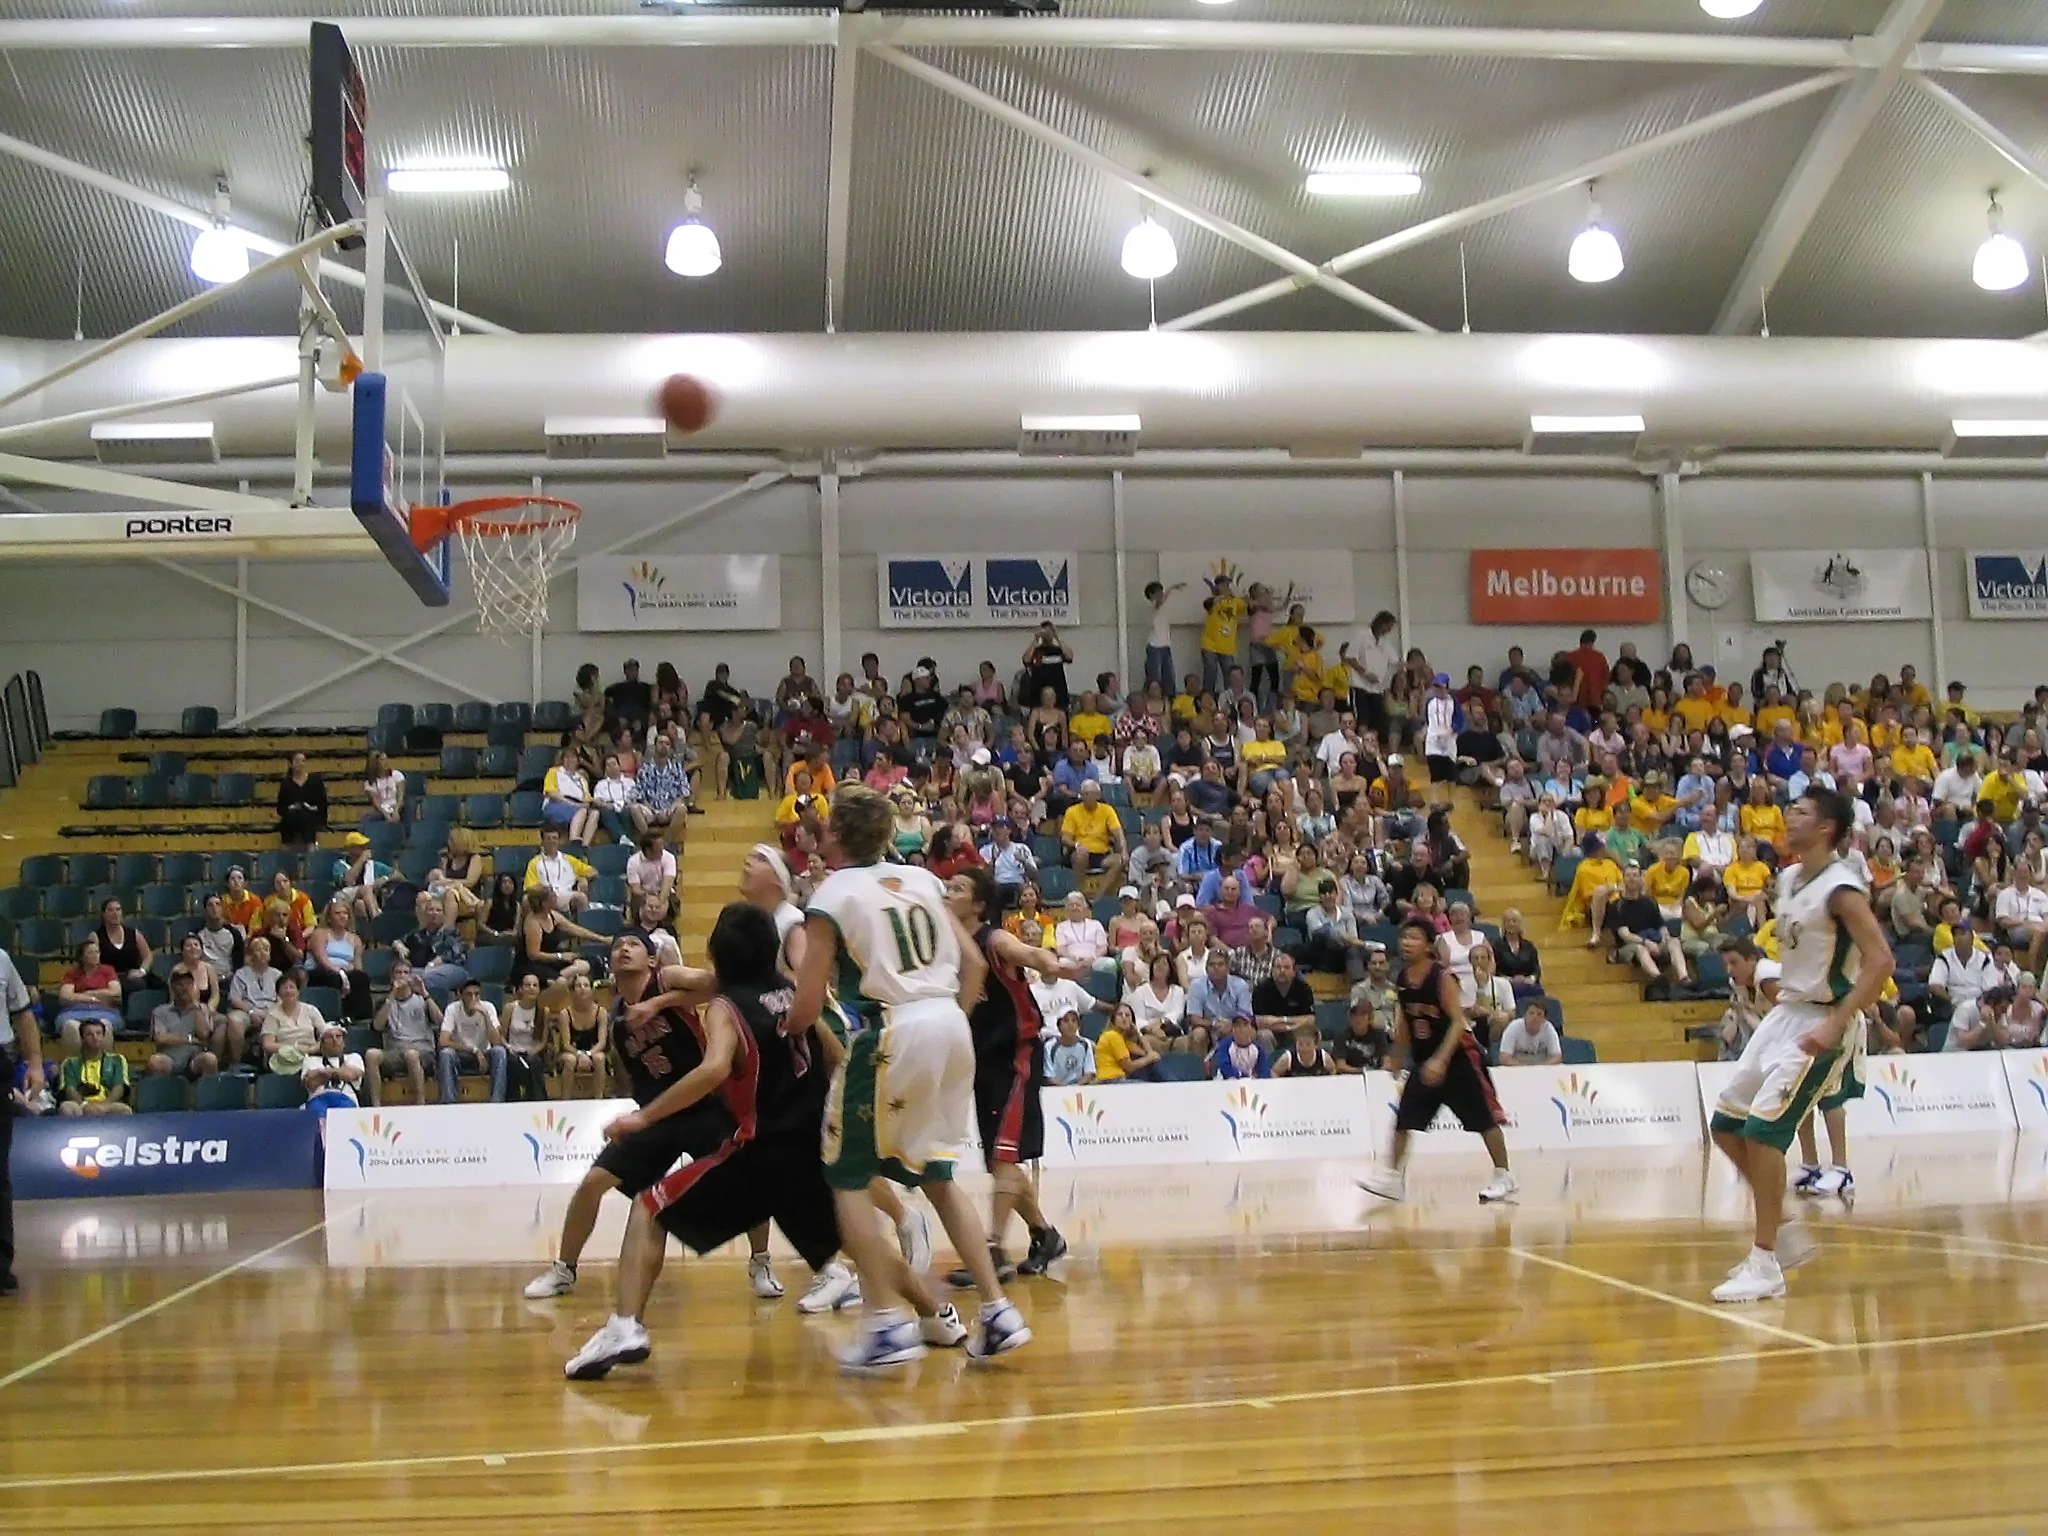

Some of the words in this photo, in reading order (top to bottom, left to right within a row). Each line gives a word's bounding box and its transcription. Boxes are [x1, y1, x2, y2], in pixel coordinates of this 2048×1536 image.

[1486, 568, 1646, 597] Melbourne
[890, 586, 970, 606] Victoria
[988, 586, 1067, 606] Victoria
[892, 609, 911, 620] The
[913, 609, 941, 619] Place
[956, 608, 970, 618] Be
[990, 609, 1008, 619] The
[1787, 606, 1838, 617] Australian
[880, 902, 938, 975] 10
[1650, 1115, 1682, 1124] GAMES
[1098, 1135, 1155, 1145] DEAFLYMPIC
[1157, 1133, 1190, 1143] GAMES
[1262, 1129, 1317, 1139] DEAFLYMPIC
[1320, 1127, 1352, 1136] GAMES
[60, 1135, 229, 1179] Telstra
[391, 1156, 450, 1166] DEAFLYMPIC
[453, 1155, 488, 1164] GAMES
